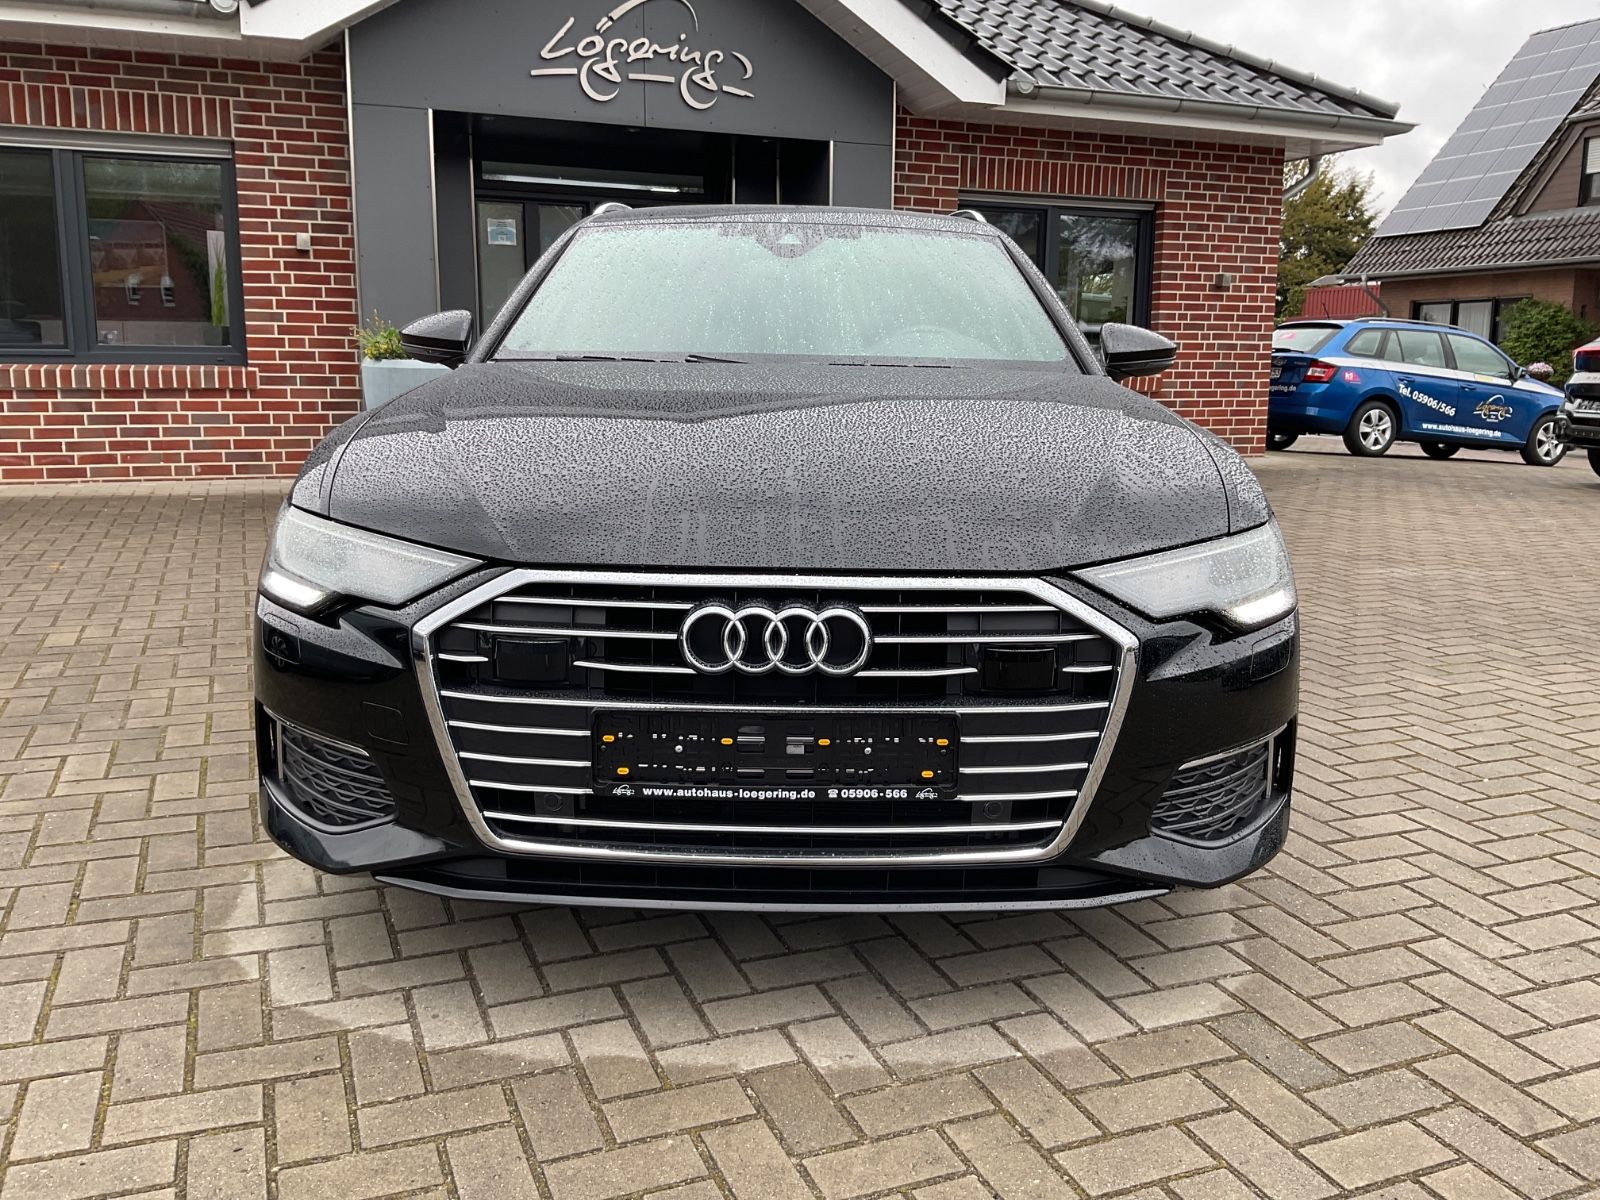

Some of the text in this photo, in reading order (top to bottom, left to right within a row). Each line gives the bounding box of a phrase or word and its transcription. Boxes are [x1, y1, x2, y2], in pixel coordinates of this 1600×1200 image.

[1398, 384, 1457, 417] Tel. 05906/566
[1421, 423, 1502, 437] www.autohaus-loegering.de
[642, 787, 816, 800] www.autohaus-loegering.de
[840, 788, 908, 799] 05906-566
